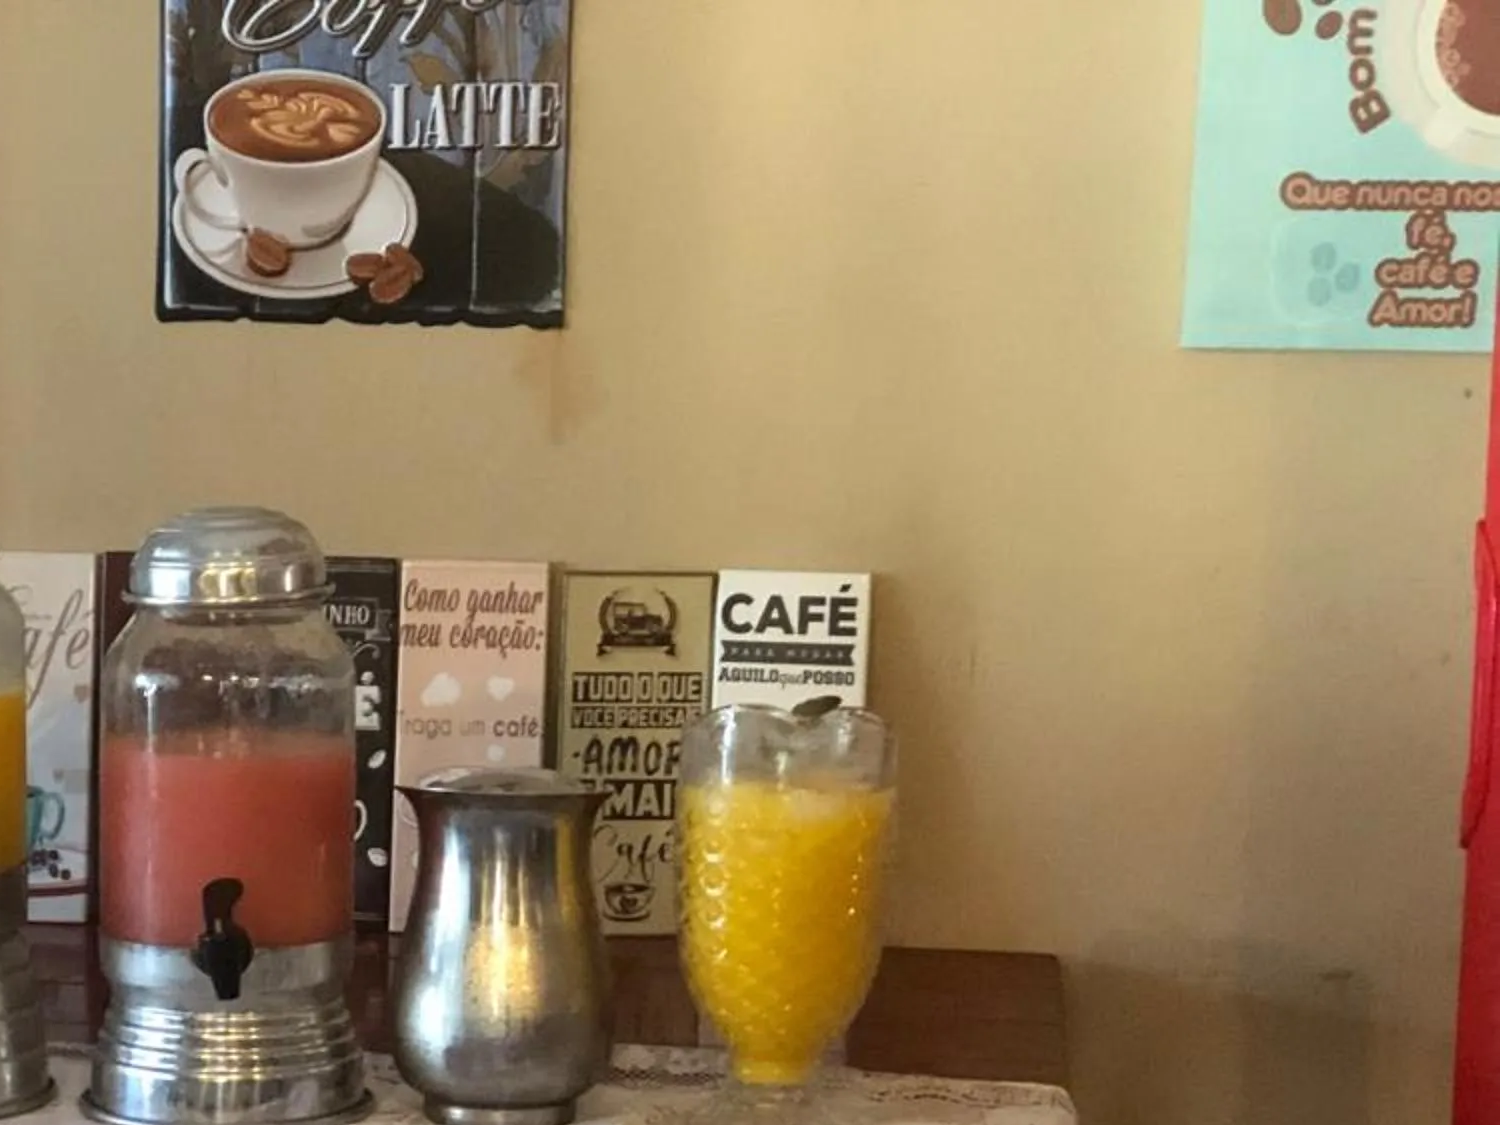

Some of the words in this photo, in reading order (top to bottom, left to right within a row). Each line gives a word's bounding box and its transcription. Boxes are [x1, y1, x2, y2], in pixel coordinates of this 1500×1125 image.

[1347, 9, 1391, 133] Bom
[388, 81, 561, 150] LATTE
[1282, 173, 1350, 208] Que
[1355, 182, 1449, 209] nunca
[1378, 253, 1449, 285] café
[1454, 263, 1479, 286] e
[1373, 292, 1474, 323] Amor!
[404, 578, 461, 613] Como
[465, 580, 544, 624] ganhar
[721, 584, 858, 637] CAFÉ
[399, 623, 442, 648] meu
[450, 619, 544, 659] coração:
[573, 674, 632, 701] TUDO
[639, 674, 652, 701] O
[659, 674, 701, 701] QUE
[603, 782, 674, 818] MAI
